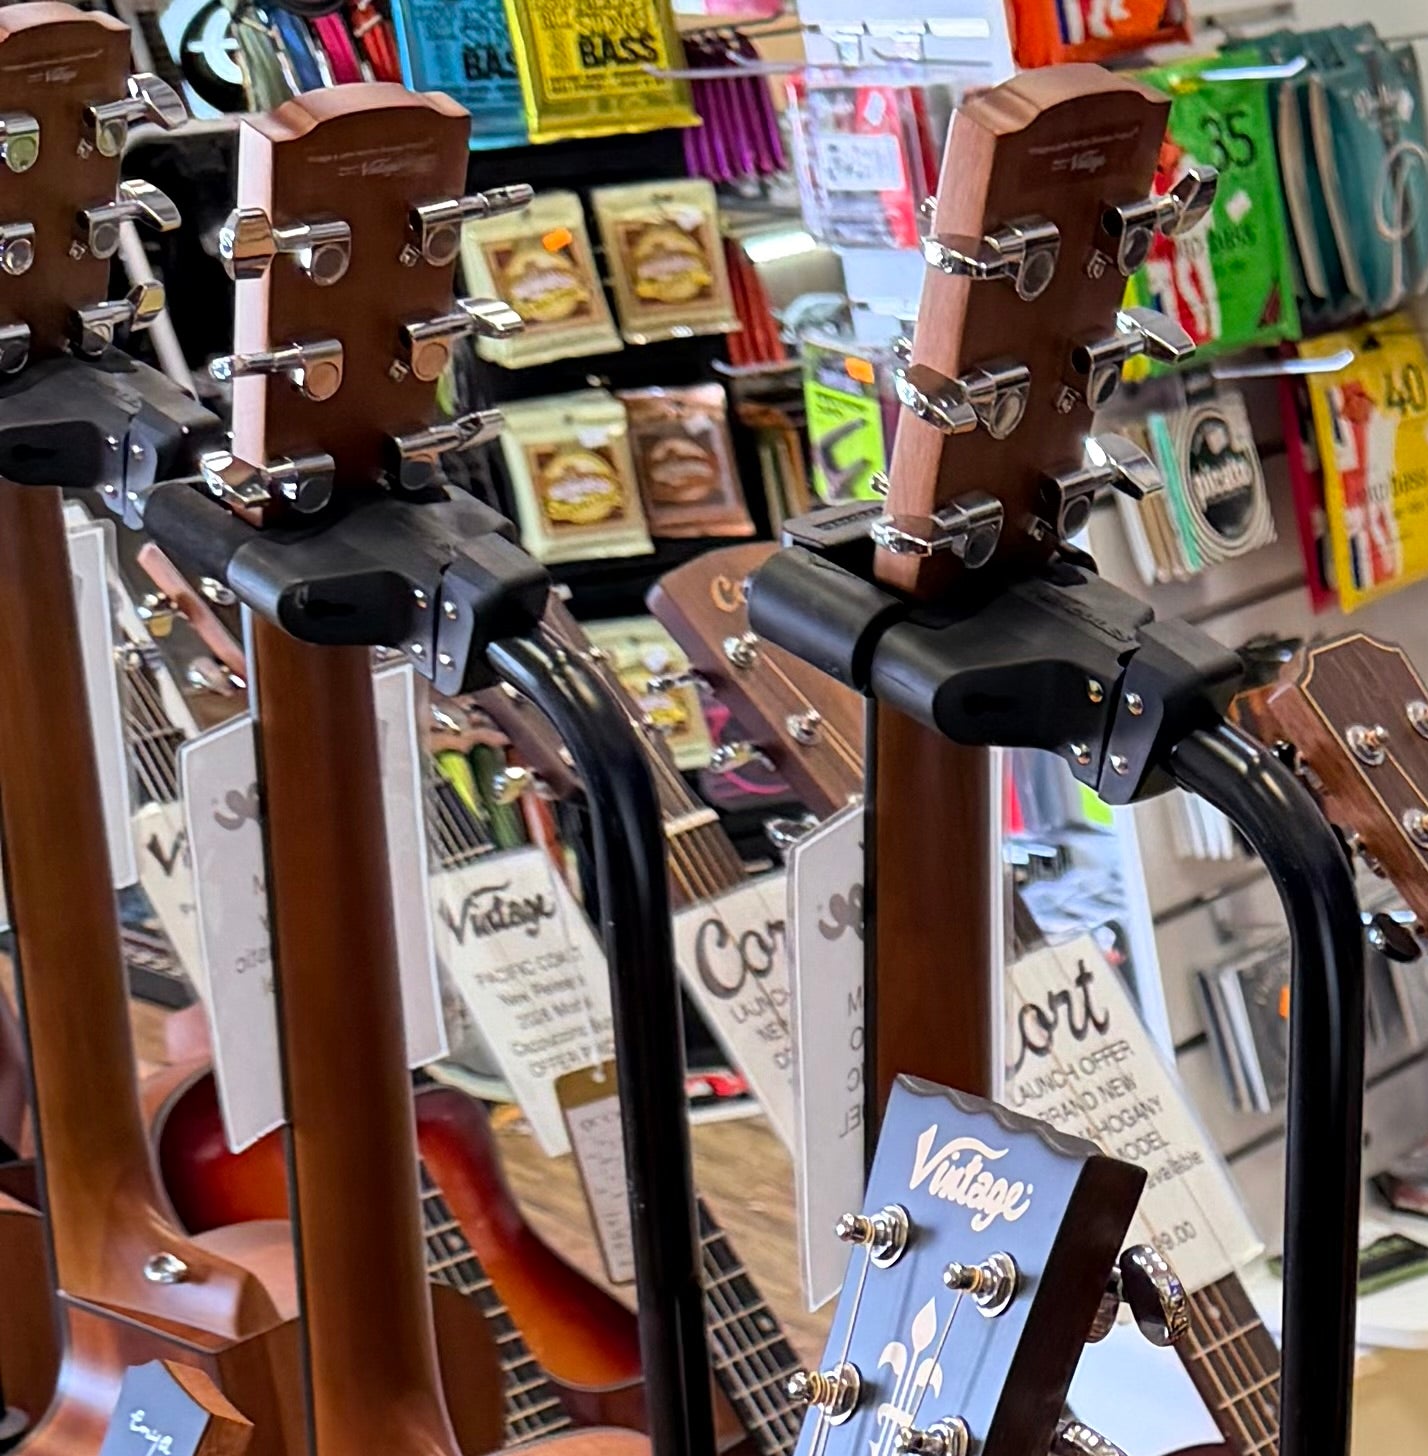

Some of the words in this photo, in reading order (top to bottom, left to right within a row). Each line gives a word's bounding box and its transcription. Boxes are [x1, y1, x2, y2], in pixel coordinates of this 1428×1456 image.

[464, 45, 518, 80] BAS
[579, 33, 658, 68] BASS
[1200, 110, 1254, 171] 35
[1383, 364, 1428, 413] 40
[438, 881, 556, 945] Vintage
[695, 918, 786, 999] Cor
[1011, 1063, 1077, 1107] LAUNCH
[1078, 1040, 1134, 1077] OFFER
[1099, 1072, 1138, 1101] NEW
[909, 1124, 1031, 1232] Vintage
